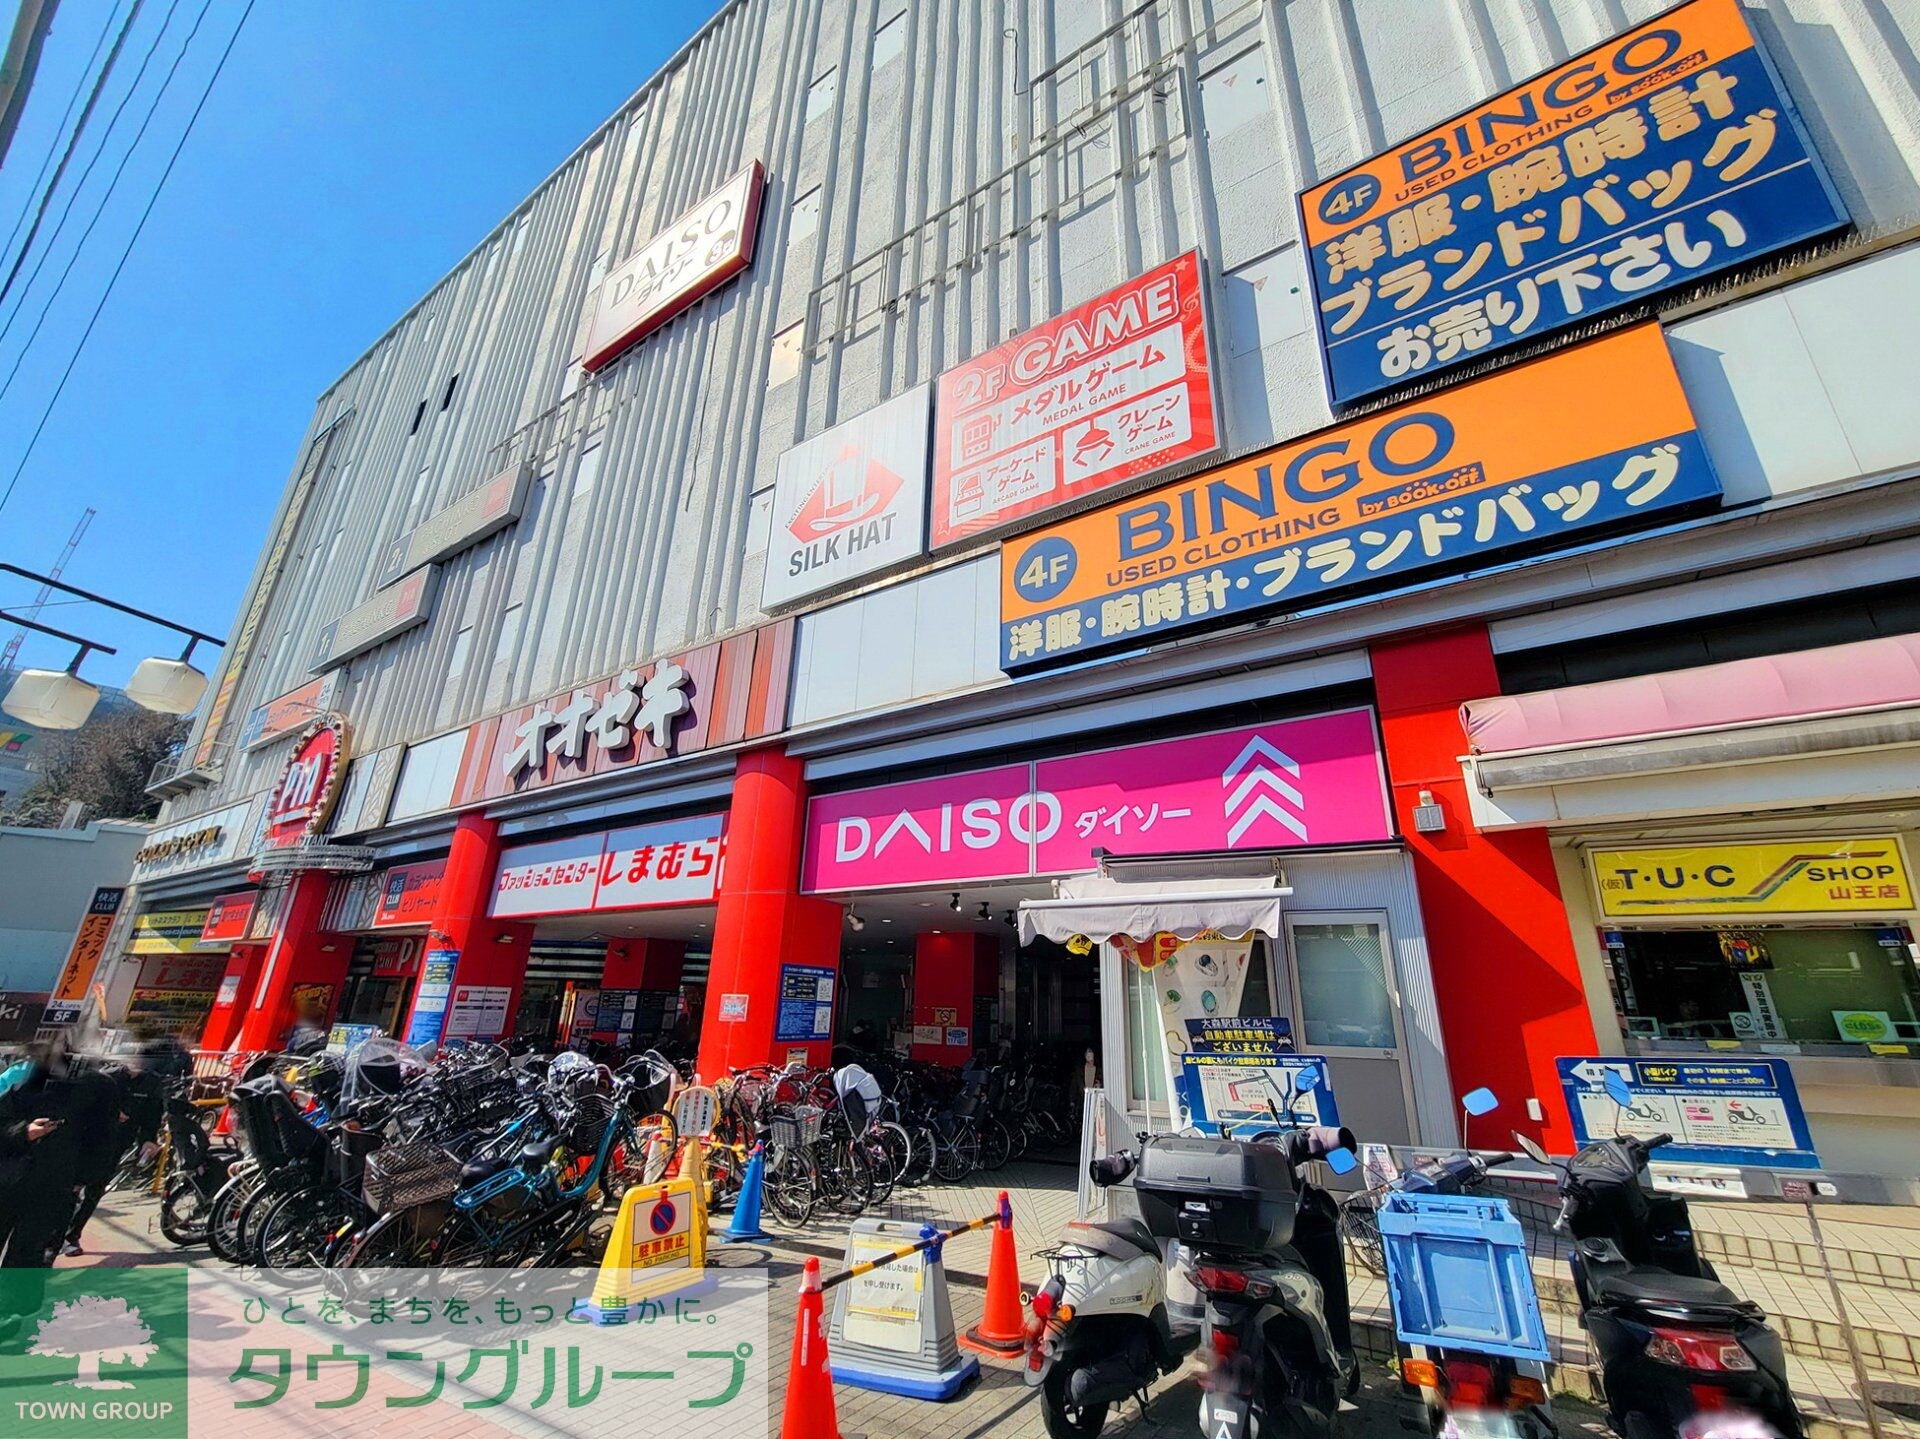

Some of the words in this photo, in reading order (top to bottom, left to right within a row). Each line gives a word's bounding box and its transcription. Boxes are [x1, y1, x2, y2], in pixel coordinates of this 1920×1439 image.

[1399, 29, 1682, 185] BINGO
[1395, 165, 1460, 201] USED
[1463, 104, 1594, 186] CLOTHING
[1321, 107, 1777, 335] ブランドバッグ
[1324, 182, 1374, 216] 4F
[611, 200, 731, 309] DAISO
[1377, 209, 1746, 378] お売り下さい
[952, 368, 1006, 408] 2F
[1012, 274, 1180, 386] GAME
[1010, 343, 1166, 427] メダルゲーム
[1042, 400, 1086, 427] MEDAL
[1088, 383, 1127, 407] GAME
[1117, 394, 1182, 430] クレーン
[1127, 415, 1174, 443] ゲーム
[987, 448, 1048, 481] アーケード
[1124, 440, 1151, 455] CRANE
[1152, 431, 1177, 447] GAME
[998, 470, 1035, 493] ゲーム
[1019, 482, 1040, 494] GAME
[1118, 413, 1456, 563] BINGO
[1362, 502, 1384, 515] by
[789, 530, 842, 578] SILK
[847, 512, 897, 556] HAT
[1106, 553, 1176, 589] USED
[1183, 508, 1342, 570] CLOTHING
[1019, 555, 1071, 590] 4F
[503, 659, 690, 777] オオゼキ
[835, 791, 1063, 864] DAISO
[1074, 803, 1192, 839] ダイソー
[498, 861, 597, 891] ファッションセンター
[602, 837, 719, 887] しまむら
[1807, 865, 1895, 882] SHOP
[1829, 885, 1900, 900] 山王店
[60, 916, 99, 998] インターネット
[87, 916, 112, 960] コミック
[53, 1010, 72, 1021] 5F
[1213, 1042, 1273, 1053] ございません
